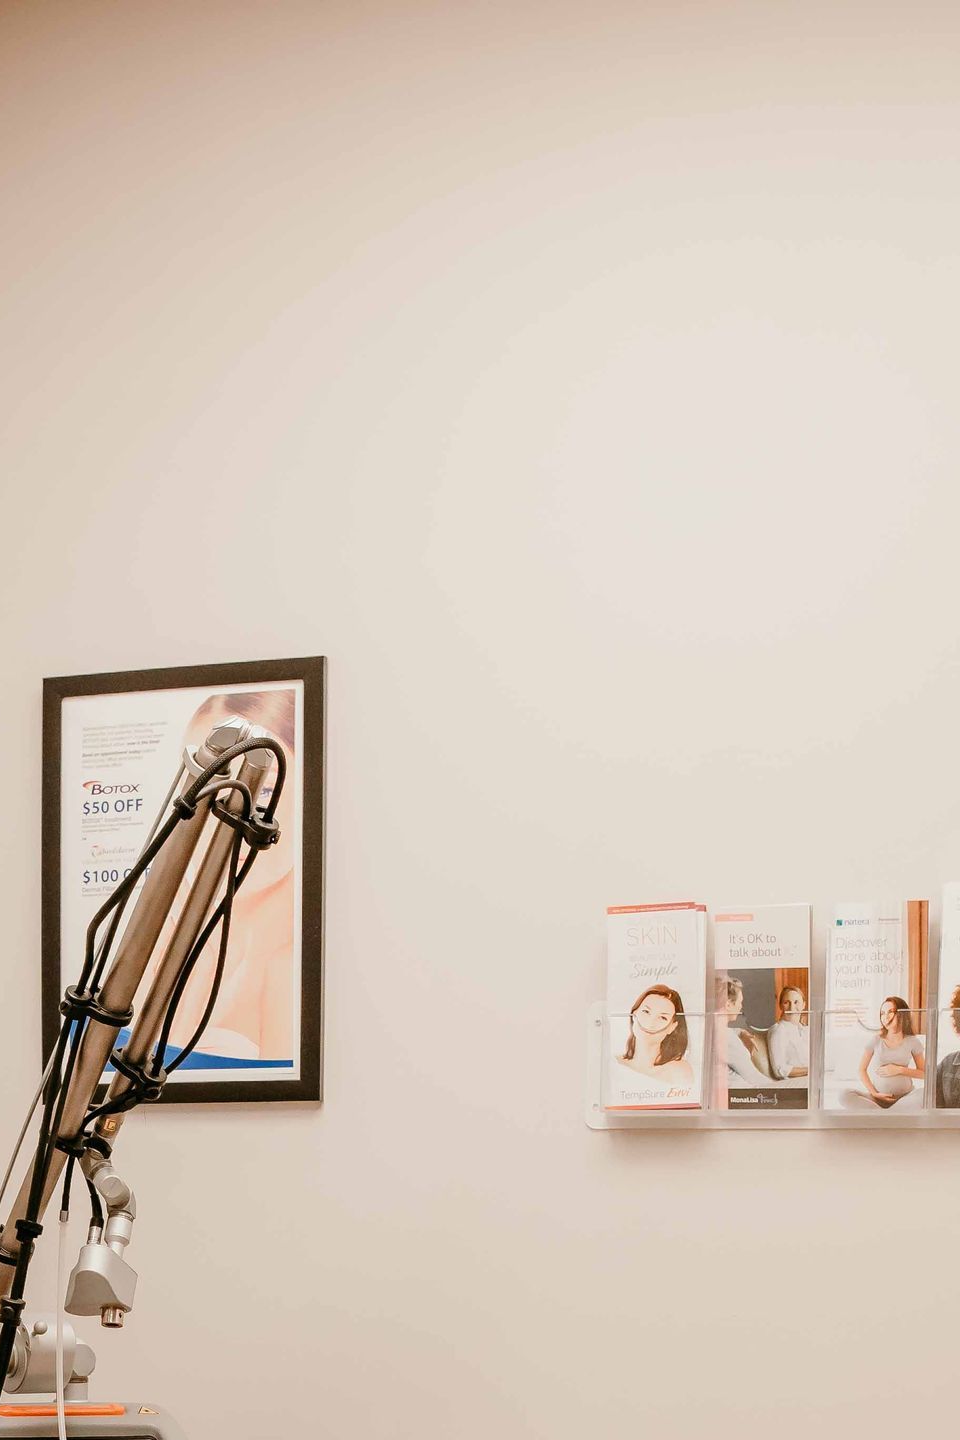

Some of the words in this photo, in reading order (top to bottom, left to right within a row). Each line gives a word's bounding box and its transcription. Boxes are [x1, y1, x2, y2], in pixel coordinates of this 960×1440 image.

[91, 783, 140, 796] BOTOX
[82, 801, 110, 816] $50
[114, 798, 144, 813] OFF
[82, 869, 119, 885] $100
[843, 918, 870, 926] natera
[626, 926, 678, 946] SKIN
[747, 933, 763, 944] OK
[766, 935, 777, 944] to
[835, 937, 888, 949] Discover
[729, 947, 749, 958] talk
[751, 947, 782, 957] about
[835, 952, 866, 961] more
[870, 949, 904, 961] about
[629, 961, 679, 981] Simple
[834, 965, 861, 976] your
[865, 962, 905, 977] baby's
[835, 978, 871, 989] health
